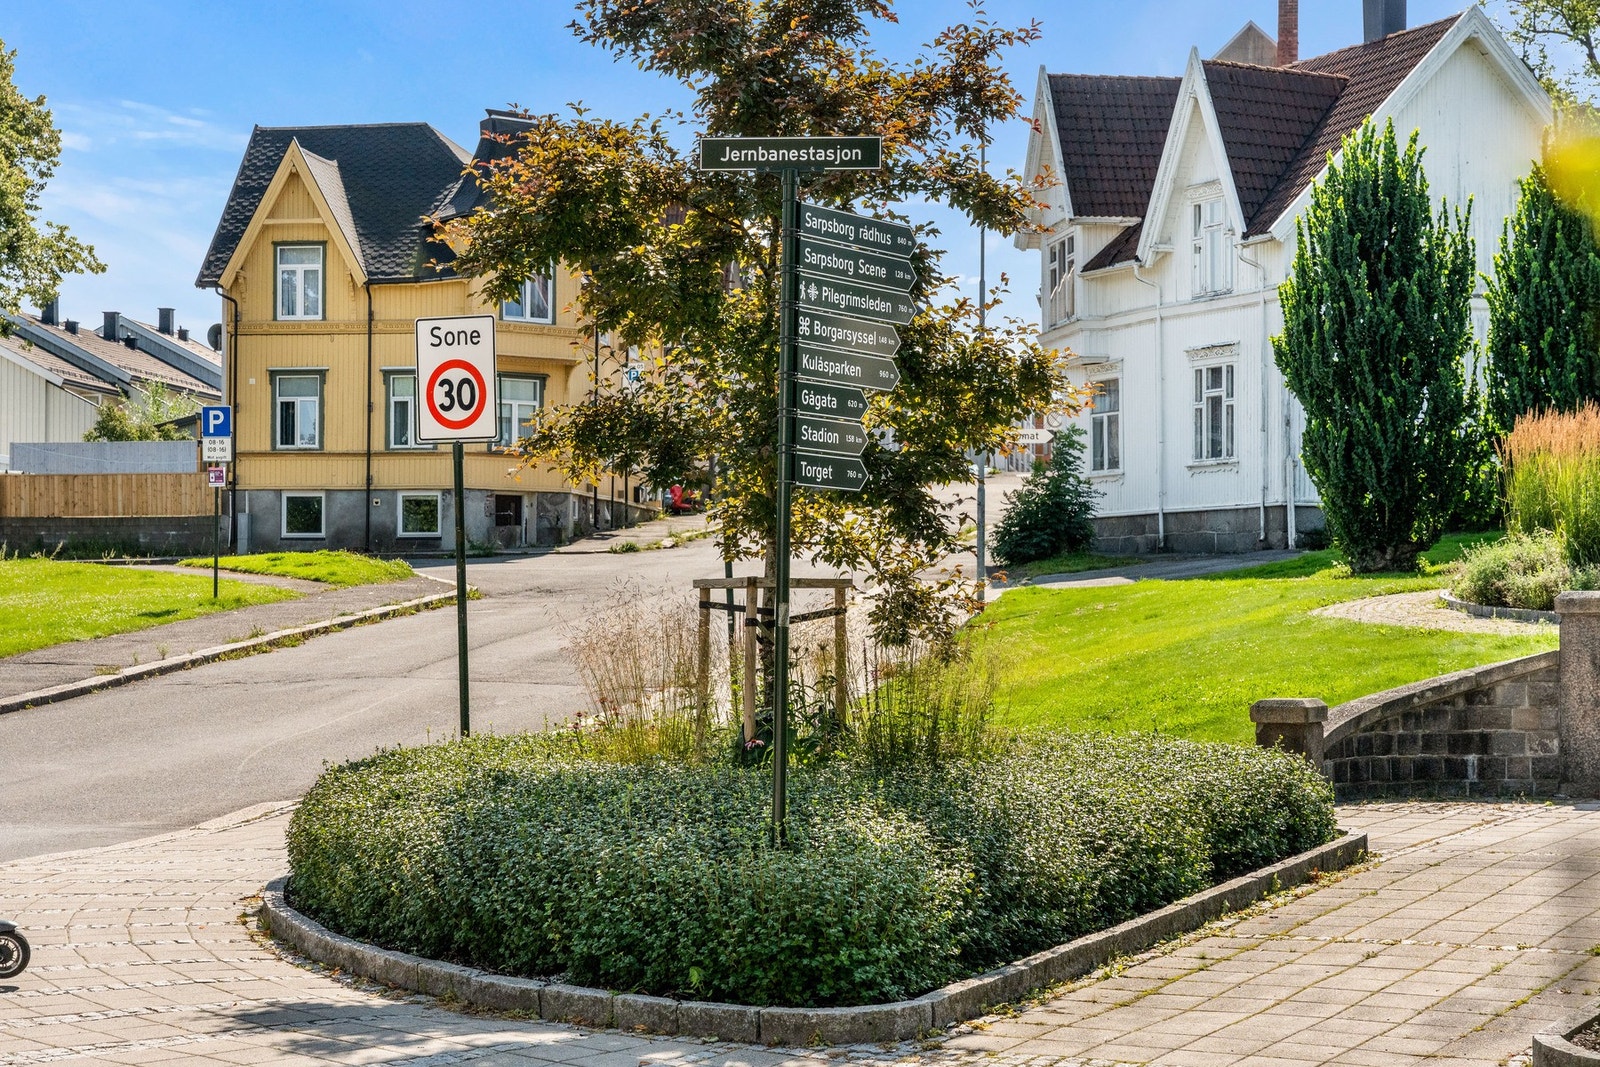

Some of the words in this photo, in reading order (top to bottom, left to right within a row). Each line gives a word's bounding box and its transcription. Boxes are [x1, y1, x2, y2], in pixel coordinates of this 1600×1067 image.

[720, 145, 862, 164] Jernbanestasjon
[805, 212, 855, 240] Sarpsborg
[859, 225, 892, 245] rådhus
[897, 236, 907, 245] 840
[804, 247, 854, 275] Sarpsborg
[858, 259, 887, 278] Scene
[904, 272, 912, 280] km
[822, 286, 892, 314] Pilegrimsleden
[898, 304, 908, 313] 760
[430, 326, 481, 347] Sone
[814, 320, 877, 346] Borgarsyssel
[888, 337, 896, 346] km
[802, 354, 862, 378] Kulåsparken
[879, 369, 889, 378] 960
[438, 377, 476, 412] 30
[801, 389, 837, 410] Gågata
[847, 399, 857, 408] 620
[208, 409, 225, 434] P
[801, 425, 839, 444] Stadion
[855, 436, 863, 444] km
[800, 461, 833, 482] Torget
[846, 470, 857, 479] 760
[857, 472, 863, 480] m
